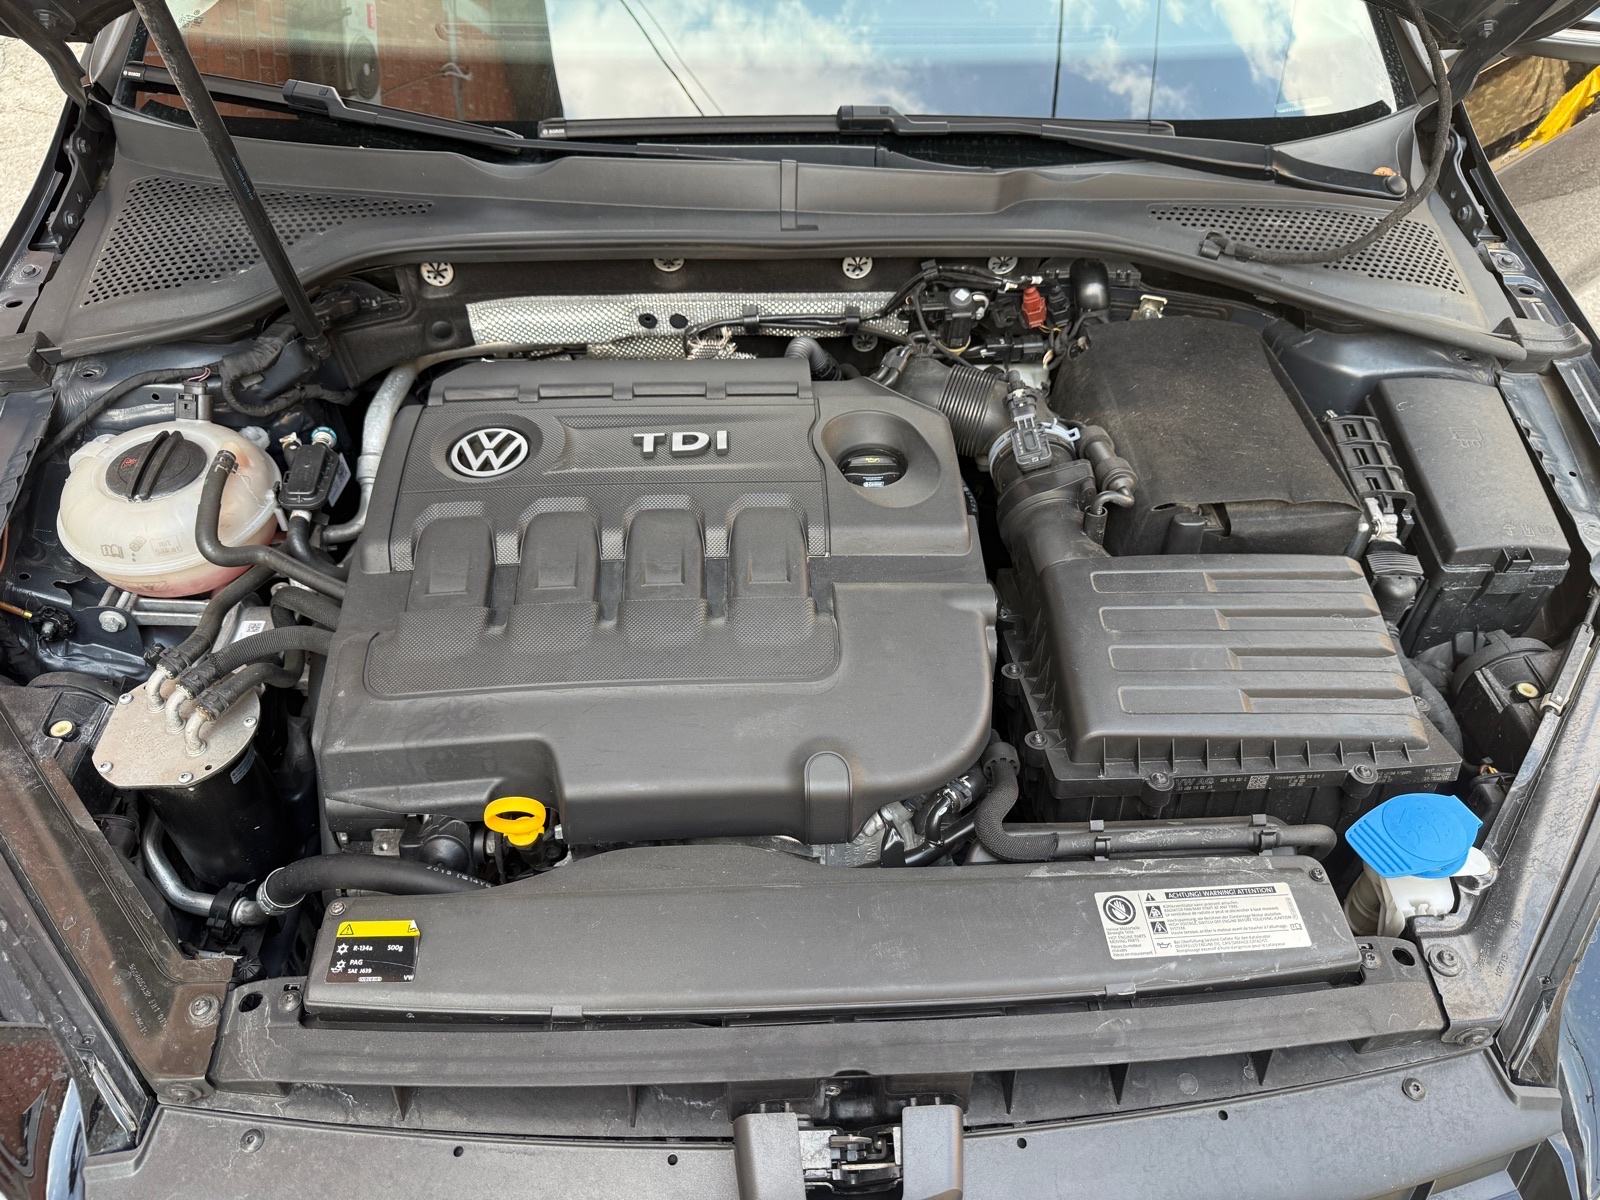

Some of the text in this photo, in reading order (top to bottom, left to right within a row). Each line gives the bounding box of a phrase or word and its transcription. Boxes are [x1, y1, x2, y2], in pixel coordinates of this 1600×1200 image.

[633, 430, 728, 454] TDI
[453, 428, 527, 476] VW
[1168, 886, 1274, 899] ACHTUNG! WARNING! ATTENTION!
[387, 944, 404, 952] 500g
